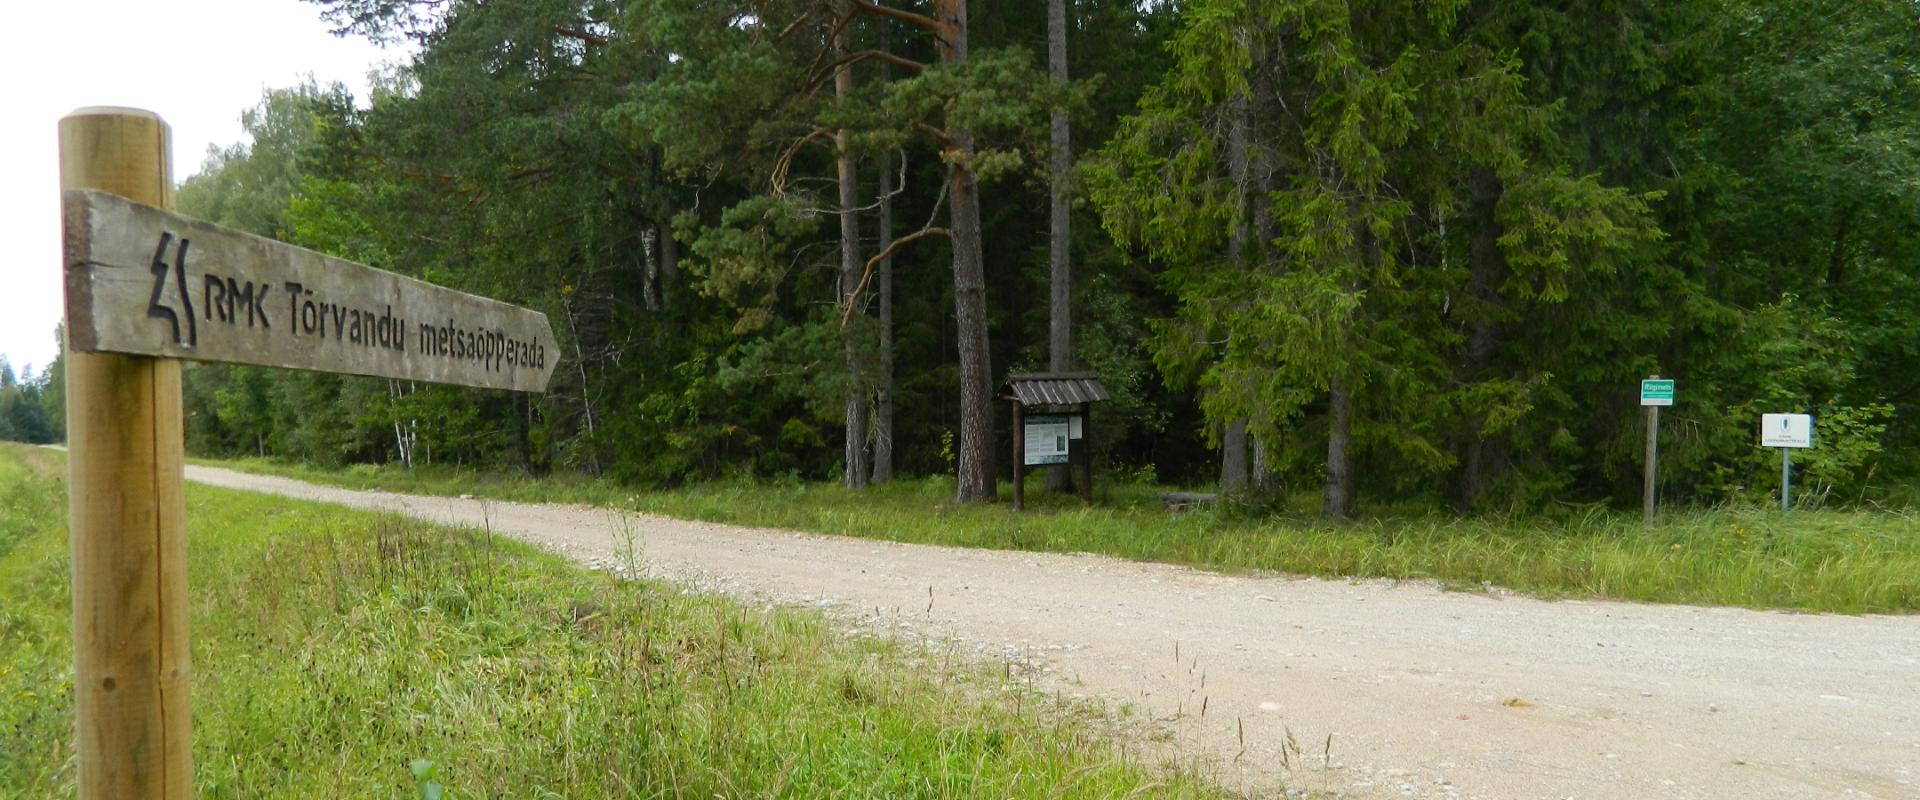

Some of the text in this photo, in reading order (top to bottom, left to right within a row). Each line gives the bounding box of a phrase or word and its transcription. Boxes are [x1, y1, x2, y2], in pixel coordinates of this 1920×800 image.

[204, 274, 545, 371] RMK Tõrvandu metsaõpperada
